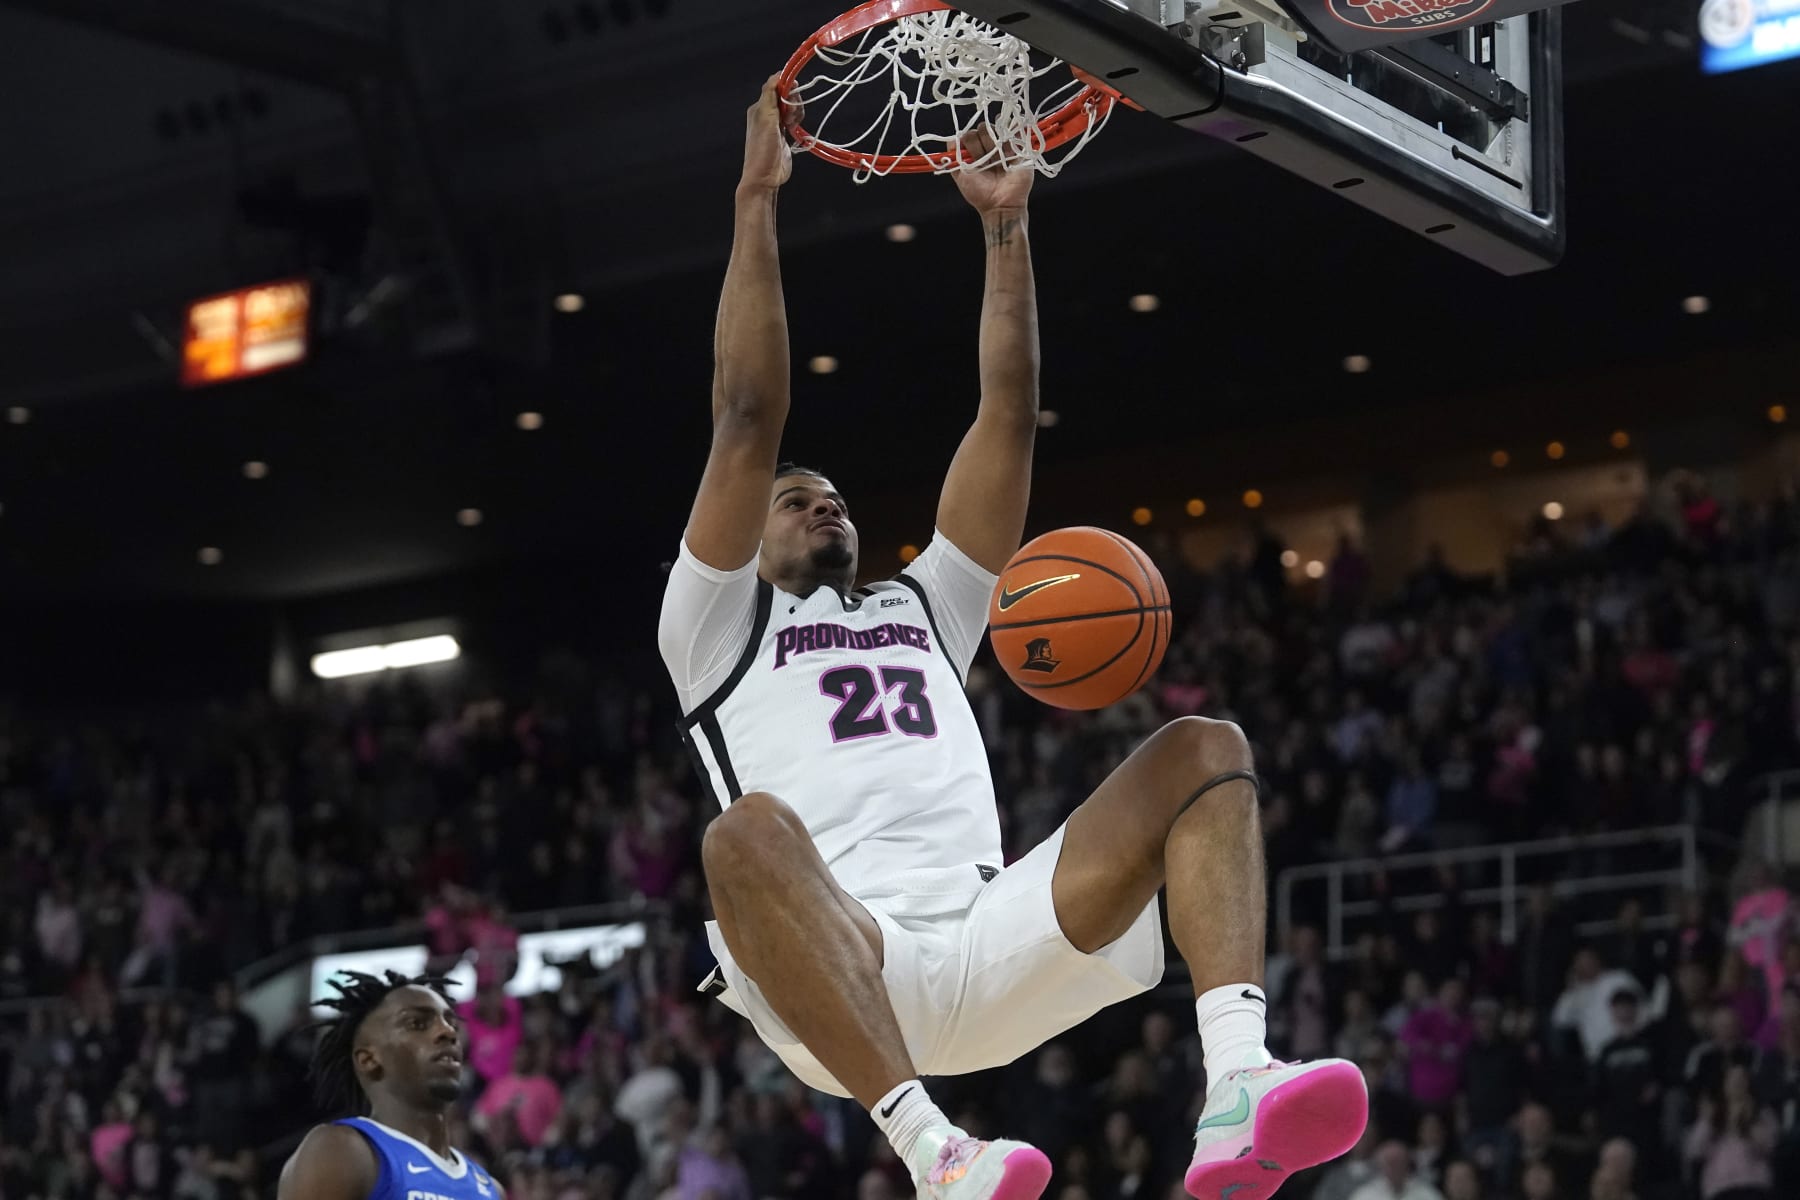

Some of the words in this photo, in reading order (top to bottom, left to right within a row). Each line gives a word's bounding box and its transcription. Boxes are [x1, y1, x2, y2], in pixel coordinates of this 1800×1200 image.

[1411, 10, 1456, 25] SUBS
[773, 622, 931, 670] PROVIDENCE
[819, 665, 938, 743] 23
